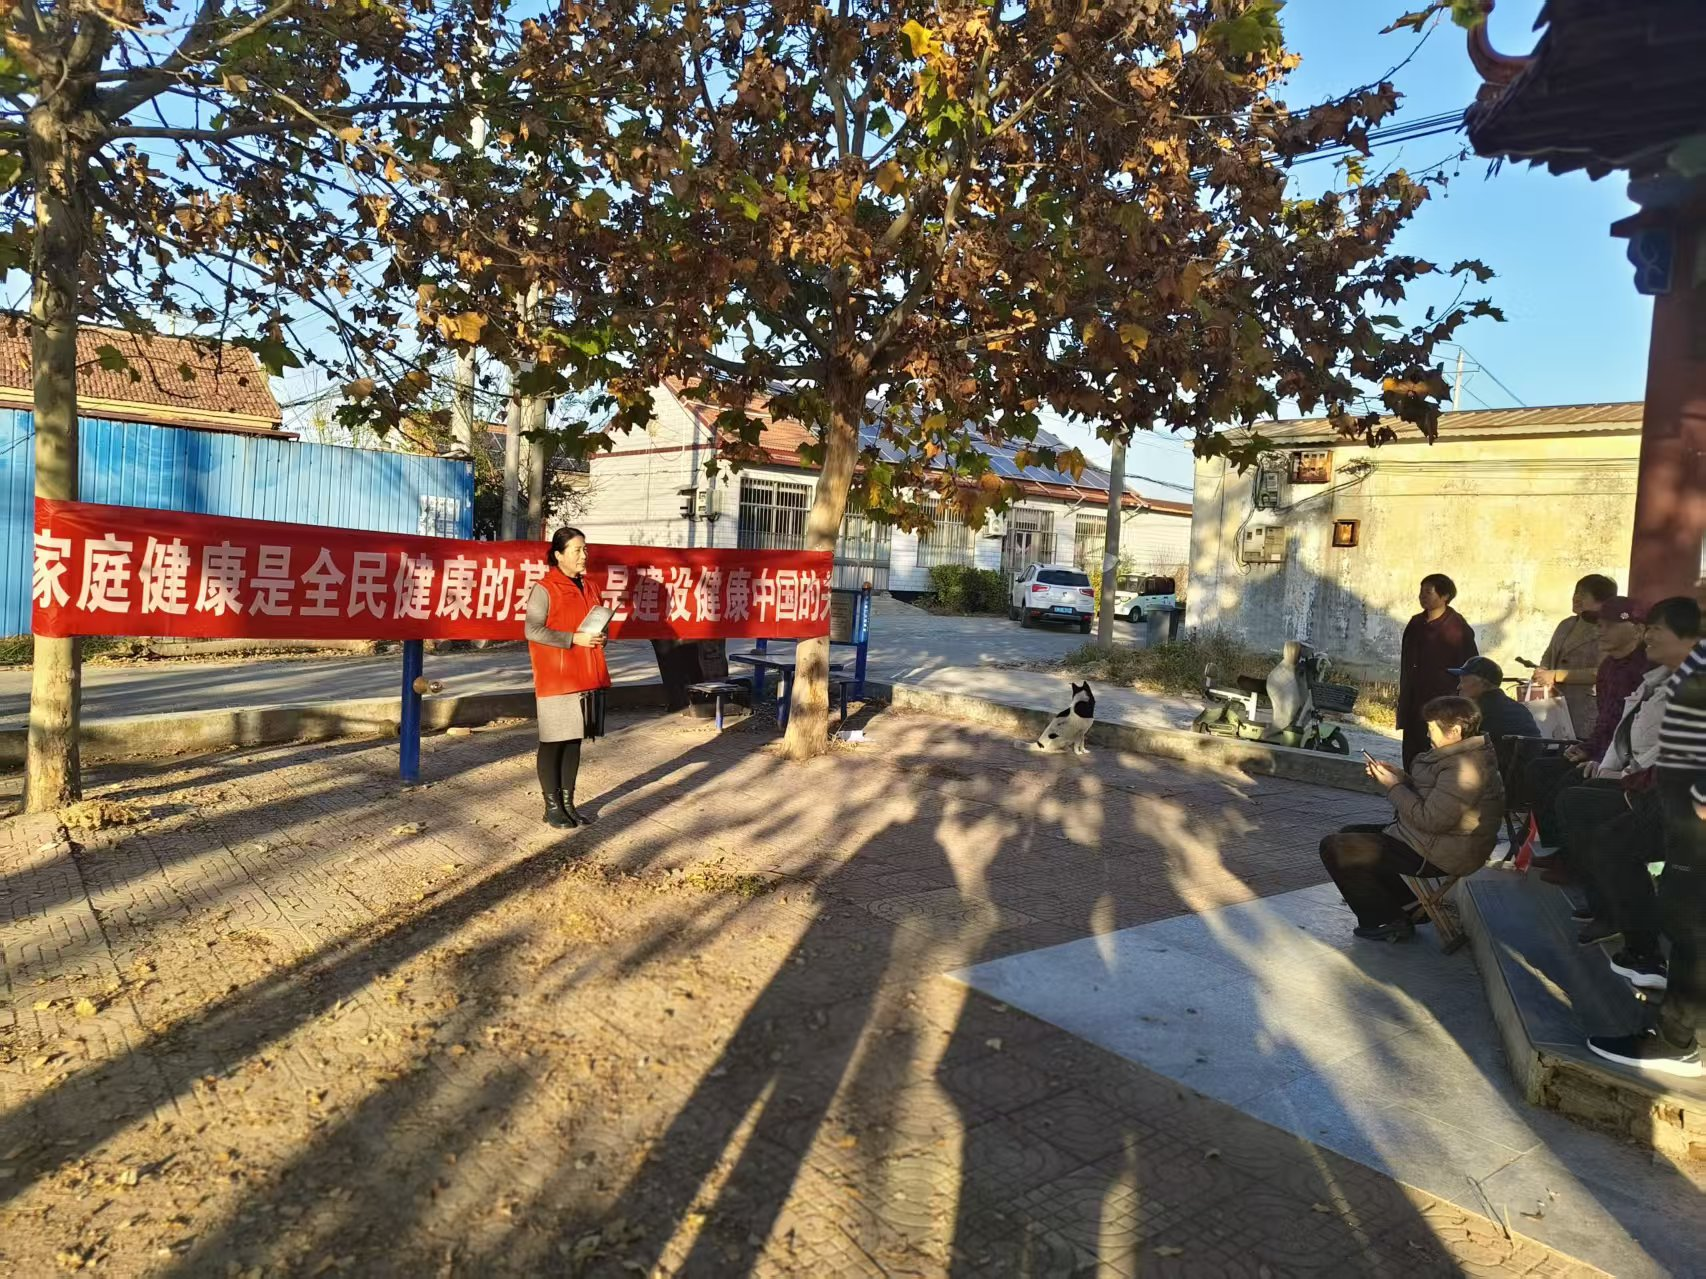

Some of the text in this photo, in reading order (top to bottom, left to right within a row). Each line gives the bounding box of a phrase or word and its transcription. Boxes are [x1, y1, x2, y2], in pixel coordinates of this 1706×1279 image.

[33, 529, 832, 622] 家庭健康是全民健康的基是建设健康中国的
